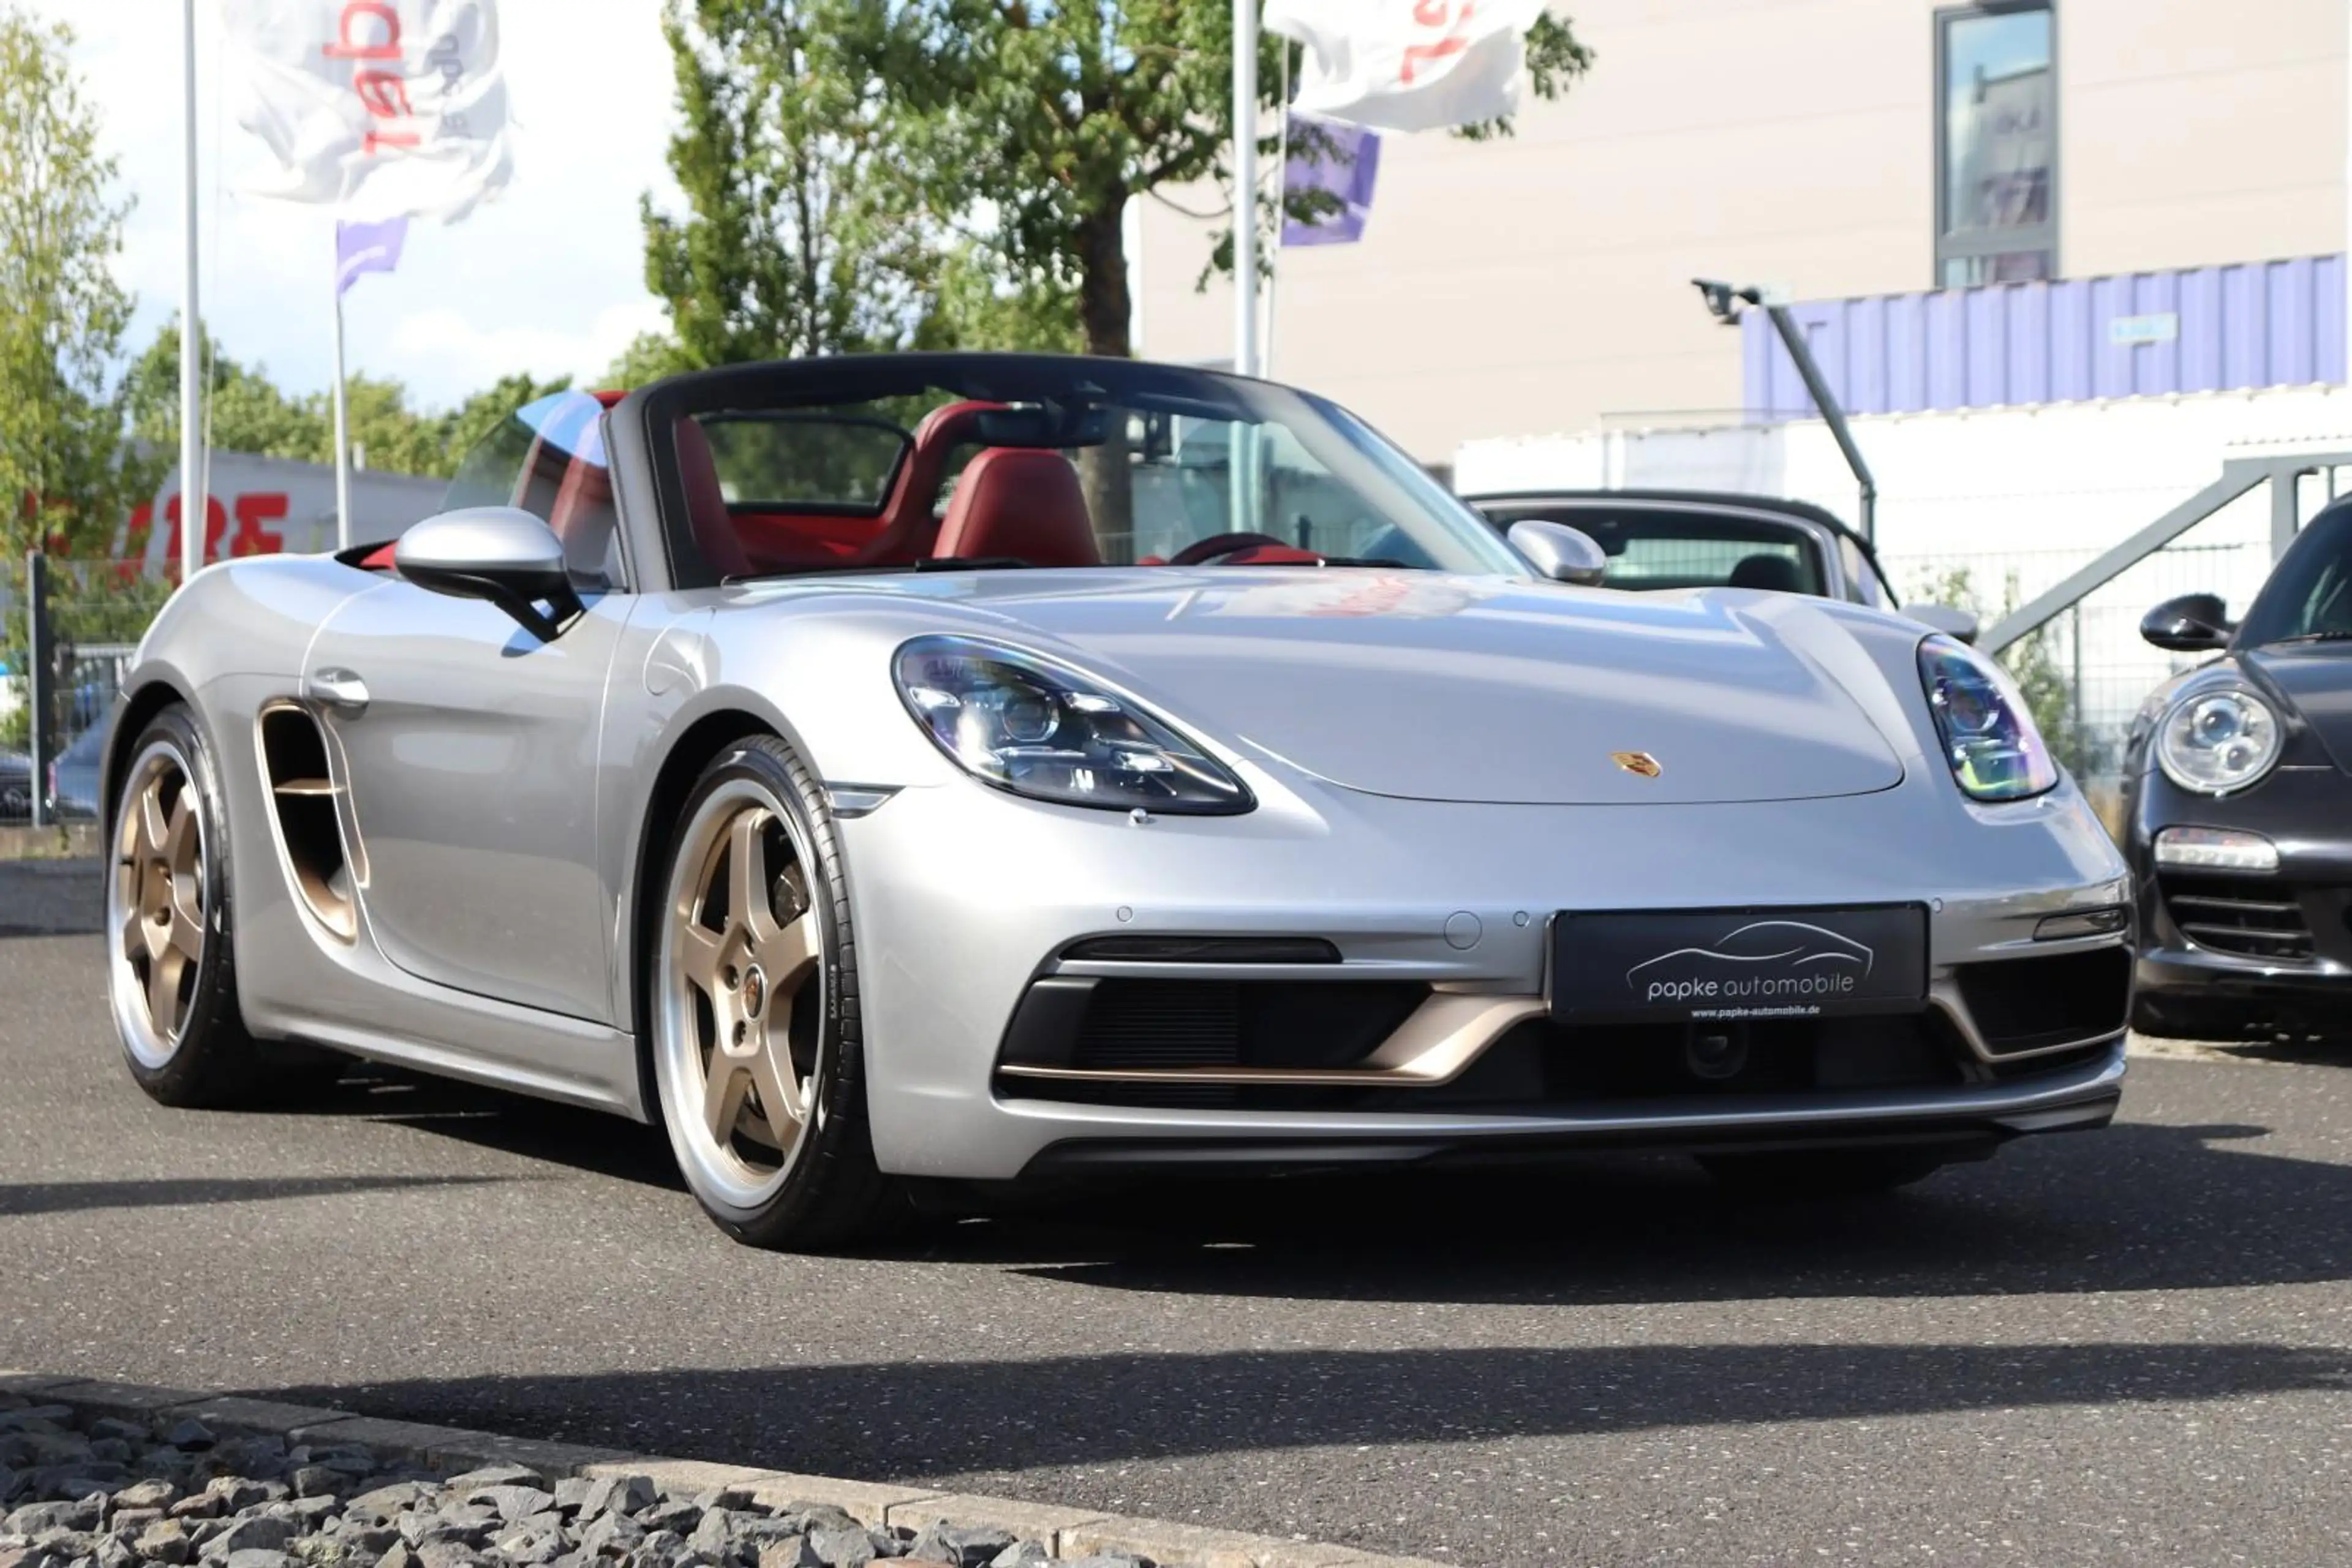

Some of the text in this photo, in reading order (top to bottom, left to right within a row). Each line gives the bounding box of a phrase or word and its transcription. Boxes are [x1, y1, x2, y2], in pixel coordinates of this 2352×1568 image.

[1648, 971, 1854, 1001] papke automobile
[1691, 1005, 1821, 1019] www.papke-automobile.de
